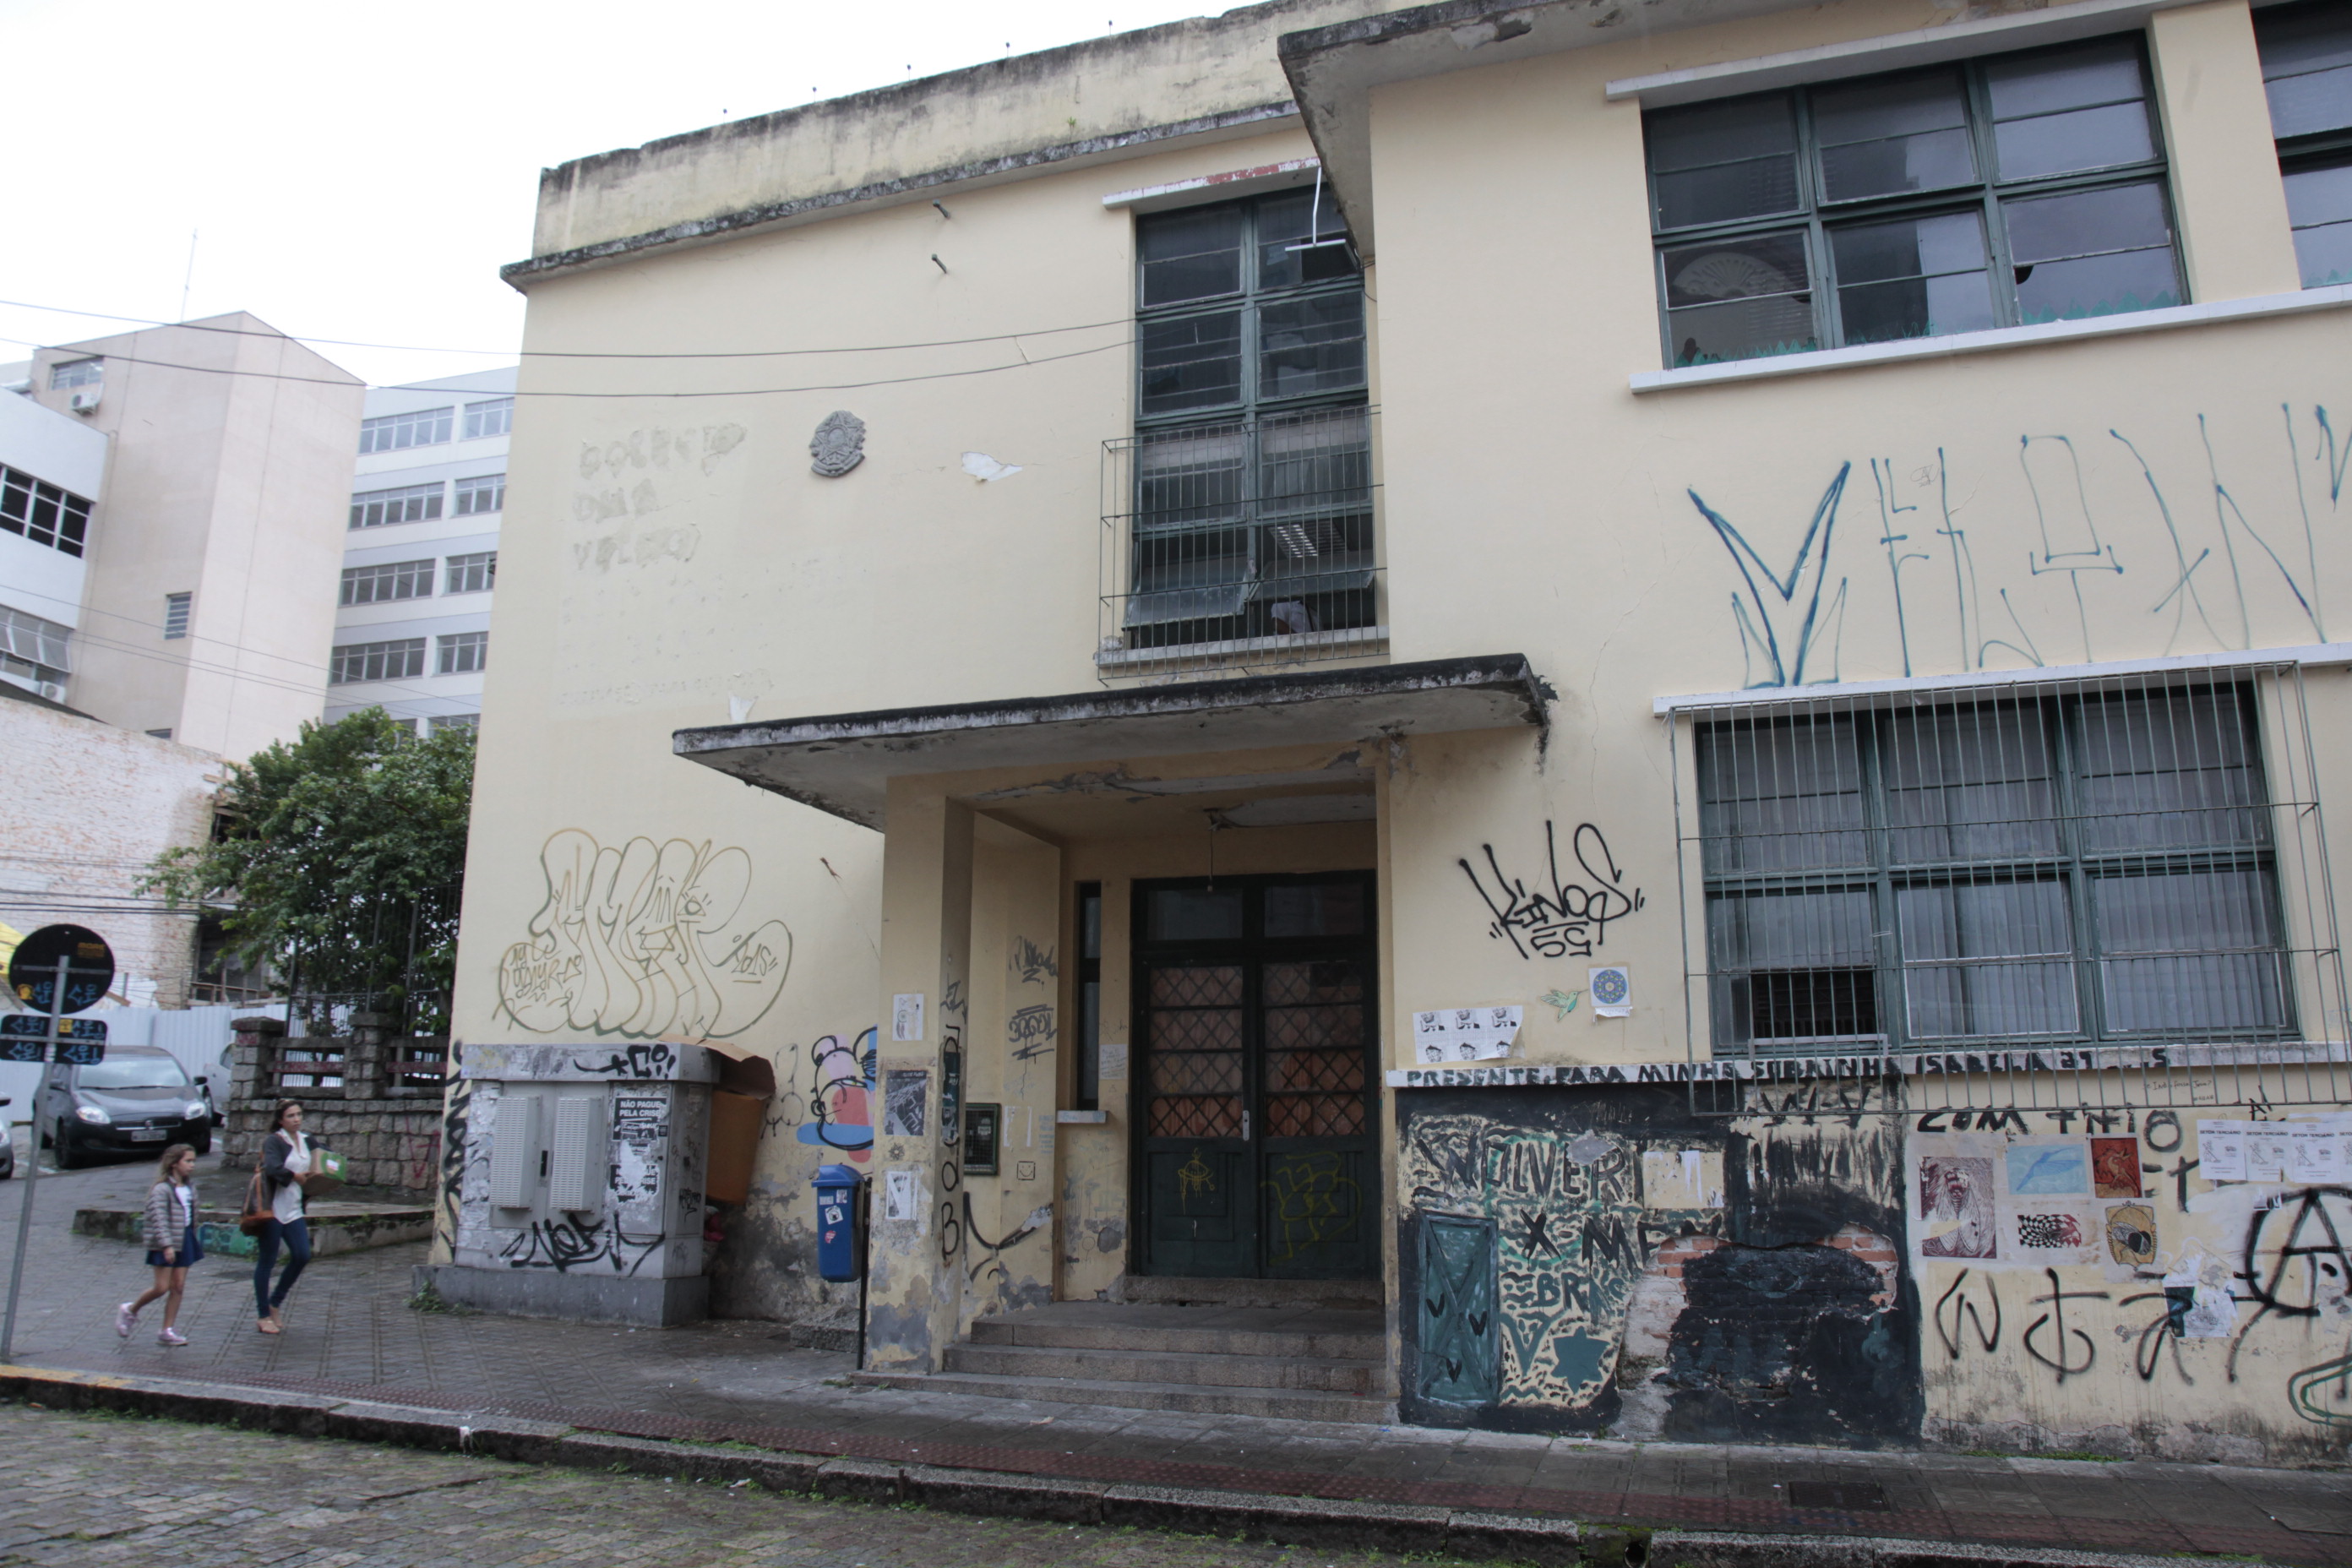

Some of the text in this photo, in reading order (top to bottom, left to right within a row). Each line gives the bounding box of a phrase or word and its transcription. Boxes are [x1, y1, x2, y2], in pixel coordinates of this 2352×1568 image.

[1554, 1065, 1626, 1086] PARA
[1915, 1052, 2051, 1074] ISABELA
[620, 1099, 635, 1108] NÃO
